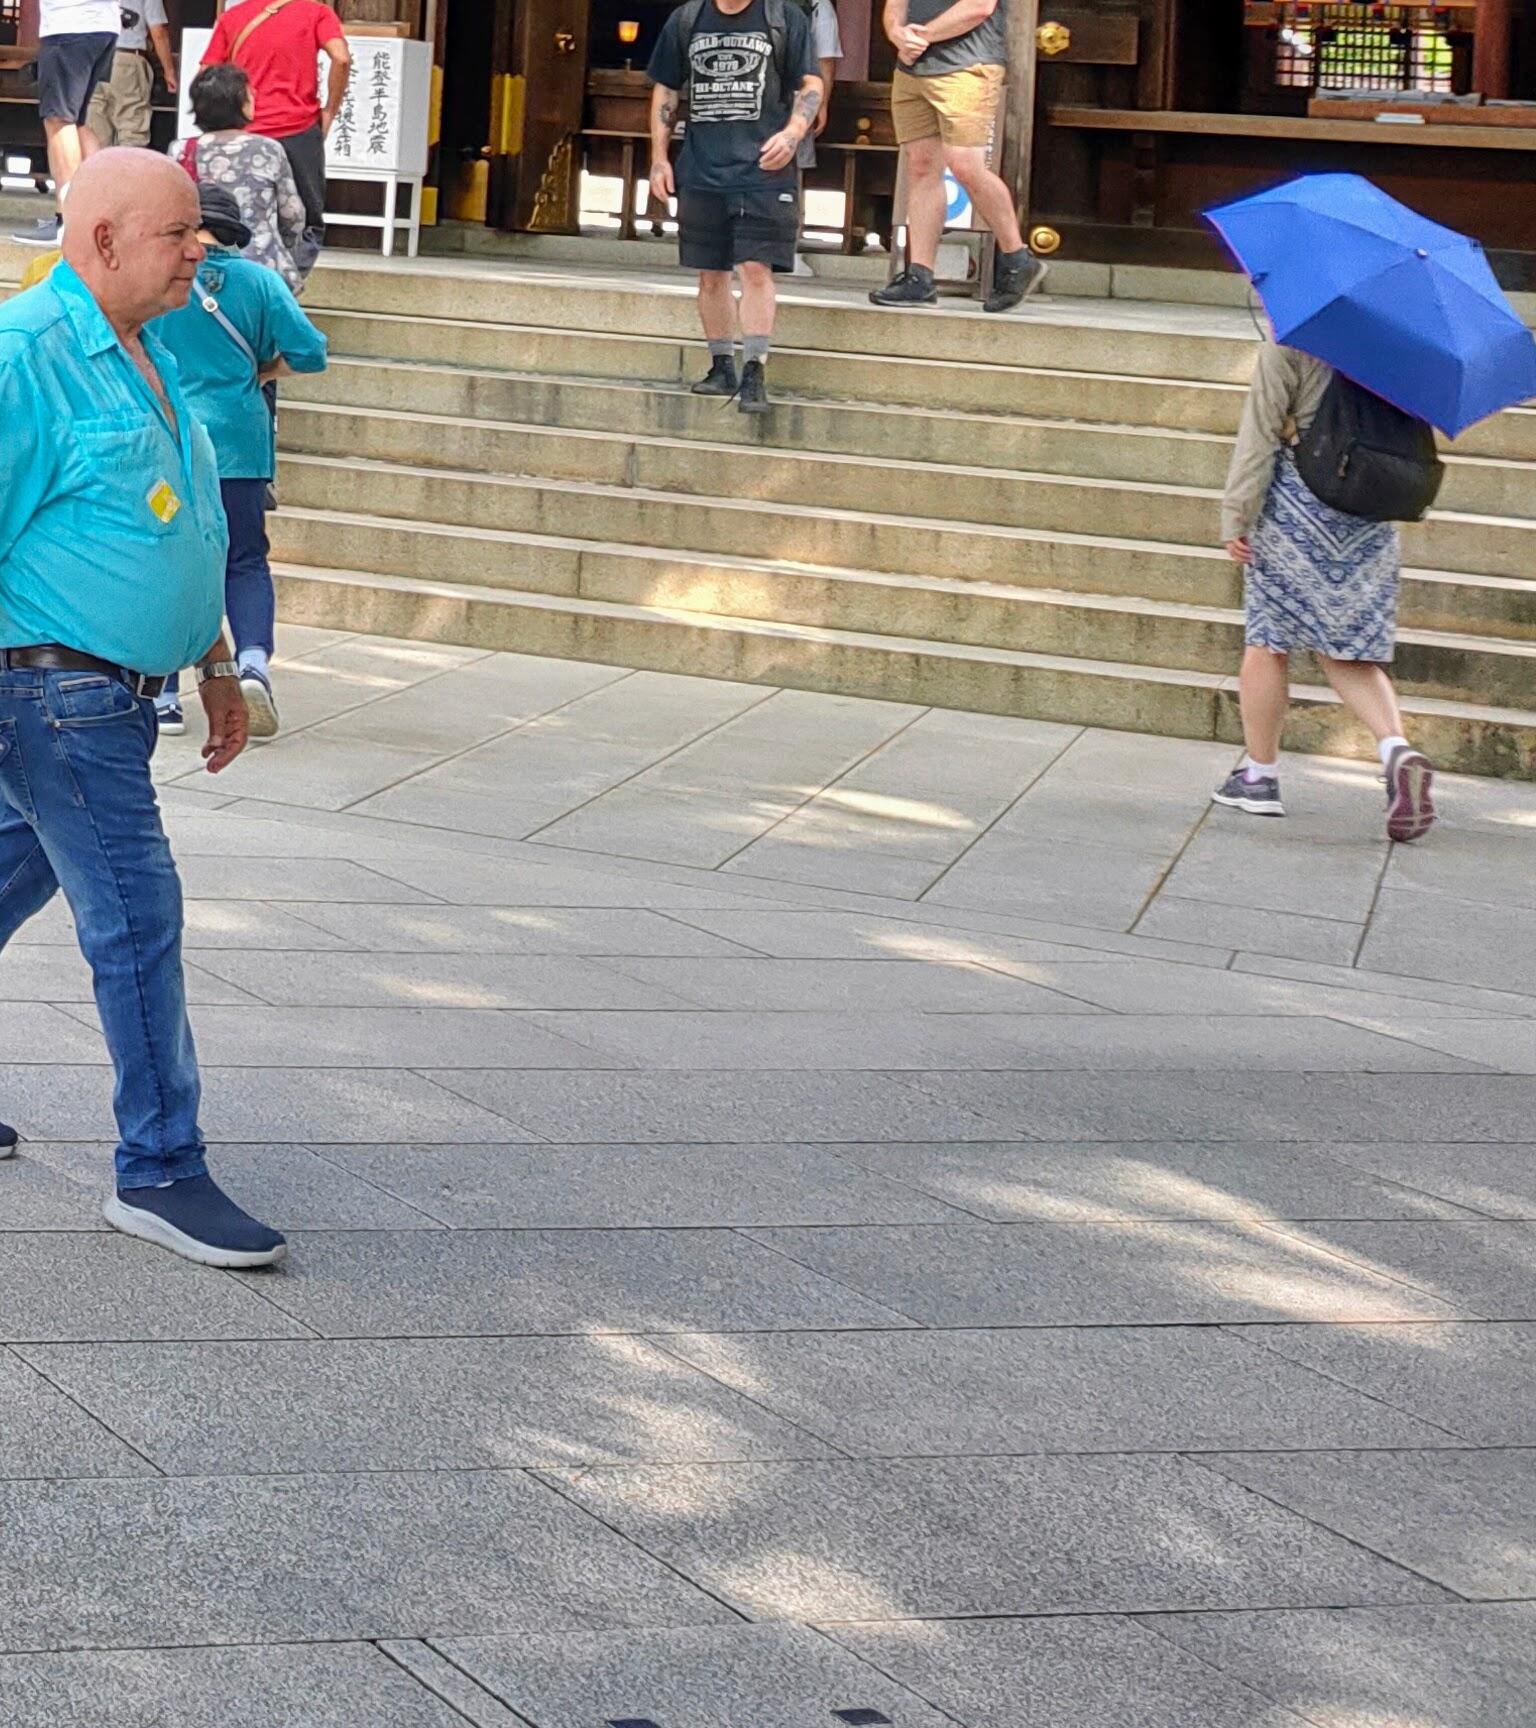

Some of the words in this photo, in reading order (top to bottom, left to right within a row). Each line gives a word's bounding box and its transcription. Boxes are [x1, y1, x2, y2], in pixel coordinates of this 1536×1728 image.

[724, 37, 772, 56] OUTLAWS
[367, 51, 391, 154] 能登半島地震
